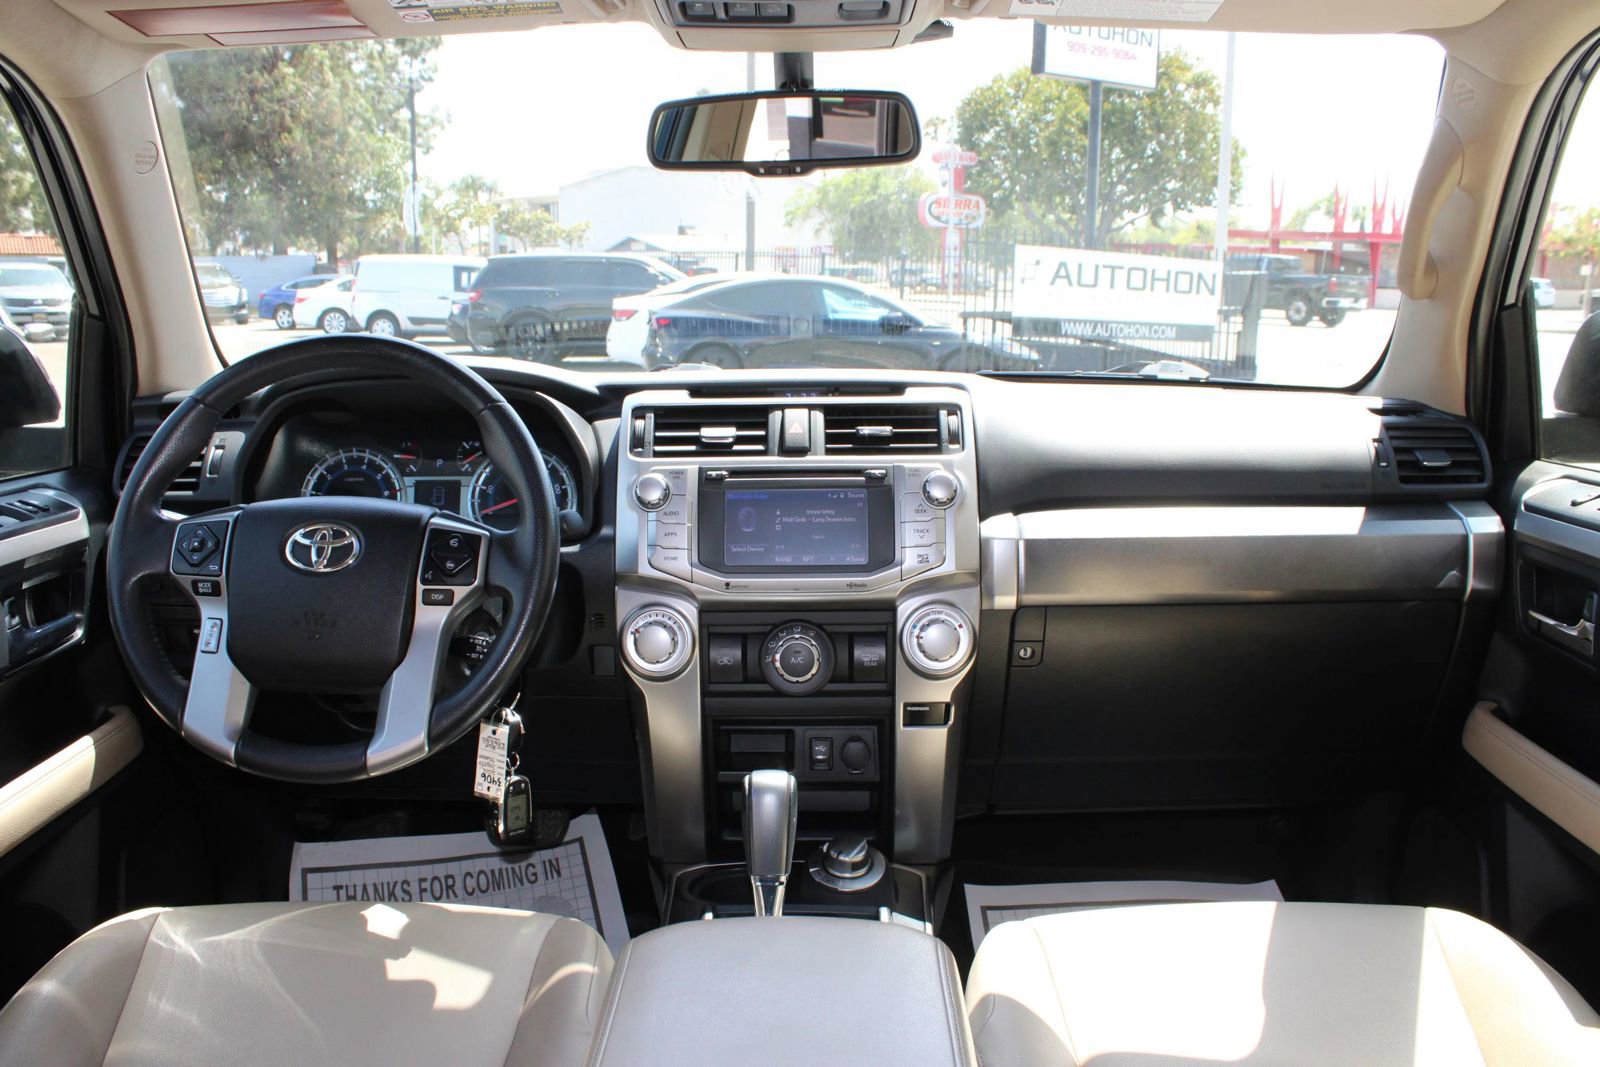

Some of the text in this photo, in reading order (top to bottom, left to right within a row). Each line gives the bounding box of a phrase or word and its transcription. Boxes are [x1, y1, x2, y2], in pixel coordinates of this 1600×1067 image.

[1050, 261, 1217, 296] AUTOHON
[1061, 321, 1177, 339] WWW.AUTOHON.COM
[790, 656, 804, 664] A/C
[480, 772, 502, 787] 3406
[332, 857, 562, 902] THANKS FOR COMING IN
